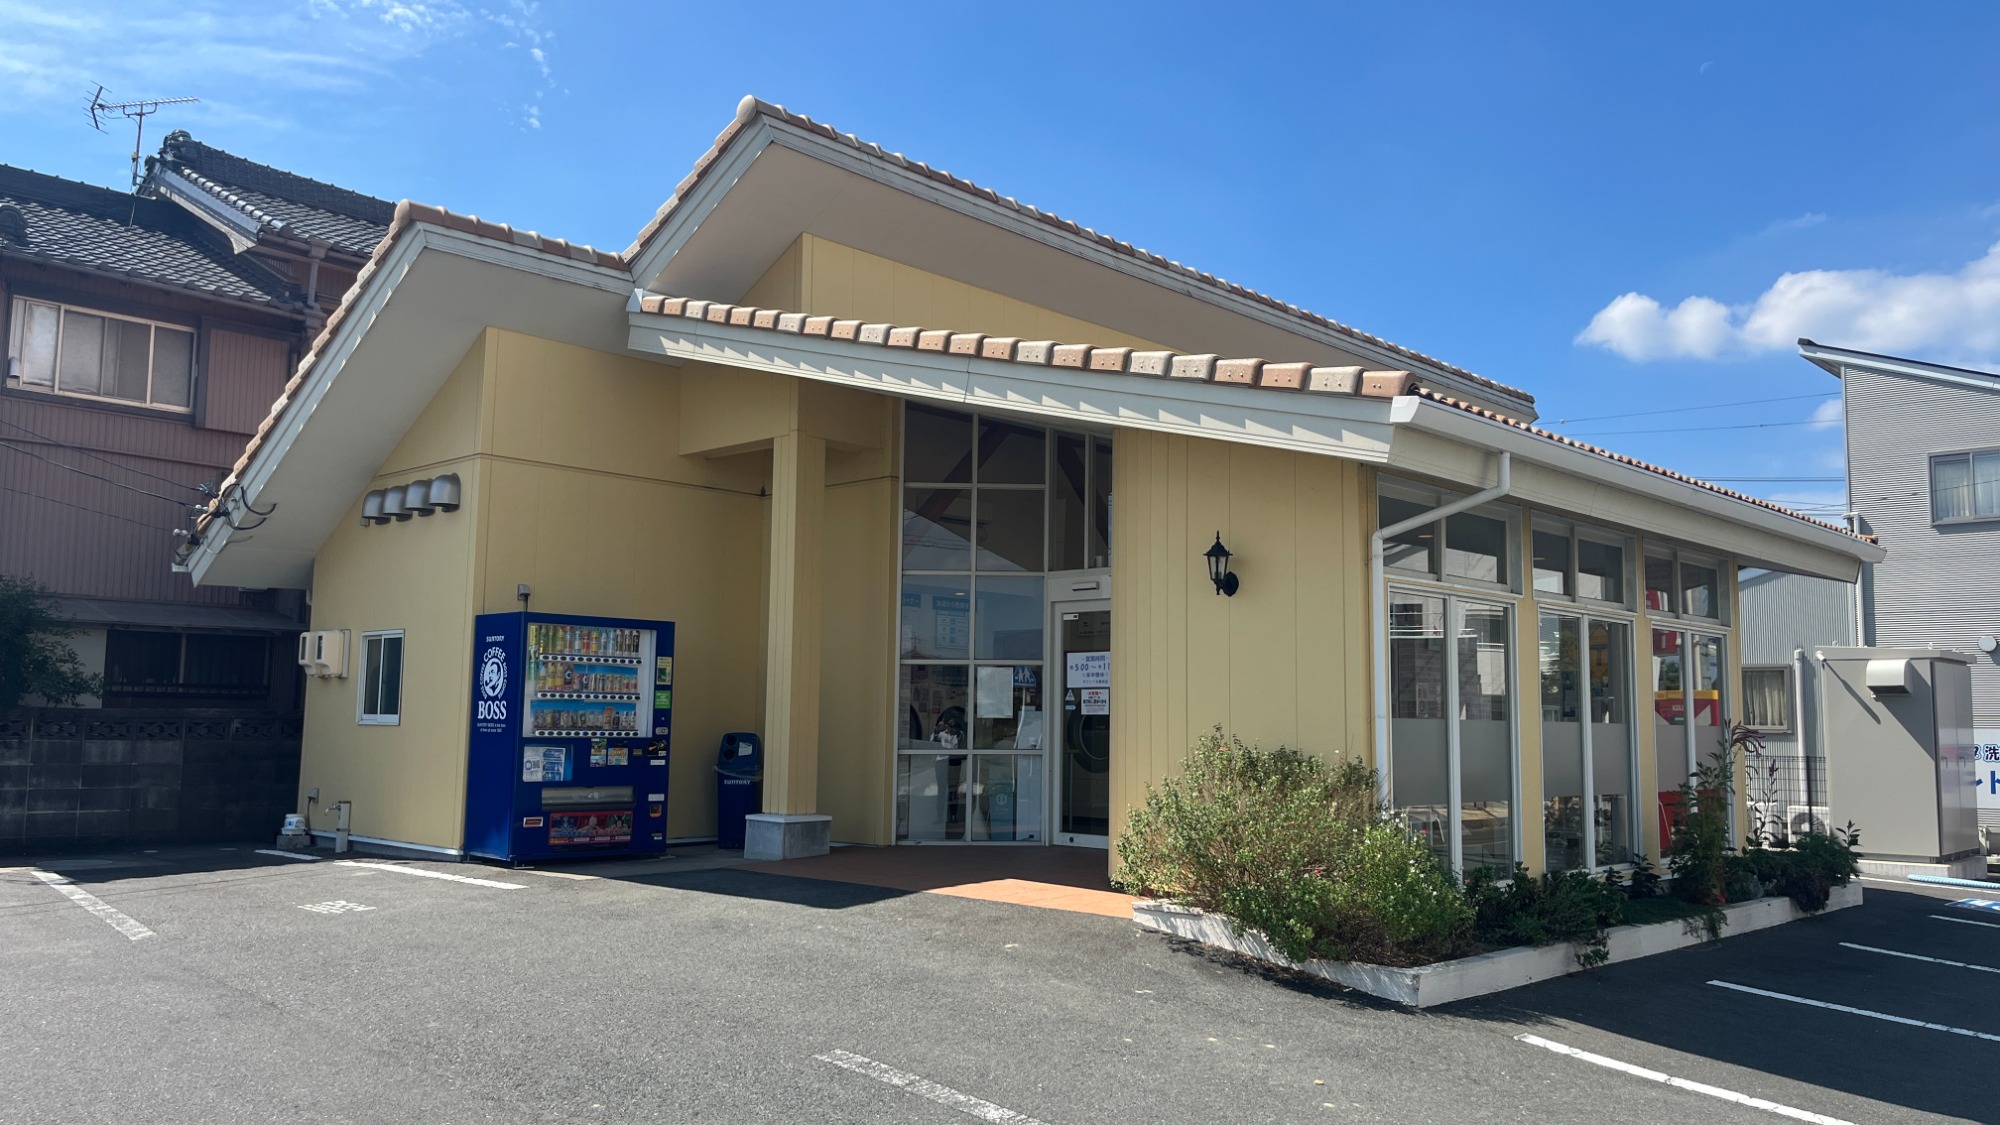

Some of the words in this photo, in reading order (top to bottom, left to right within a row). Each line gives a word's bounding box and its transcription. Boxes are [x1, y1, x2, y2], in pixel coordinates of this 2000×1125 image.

[486, 635, 504, 643] SUNTORY
[483, 646, 506, 662] COFFEE
[477, 700, 507, 720] BOSS
